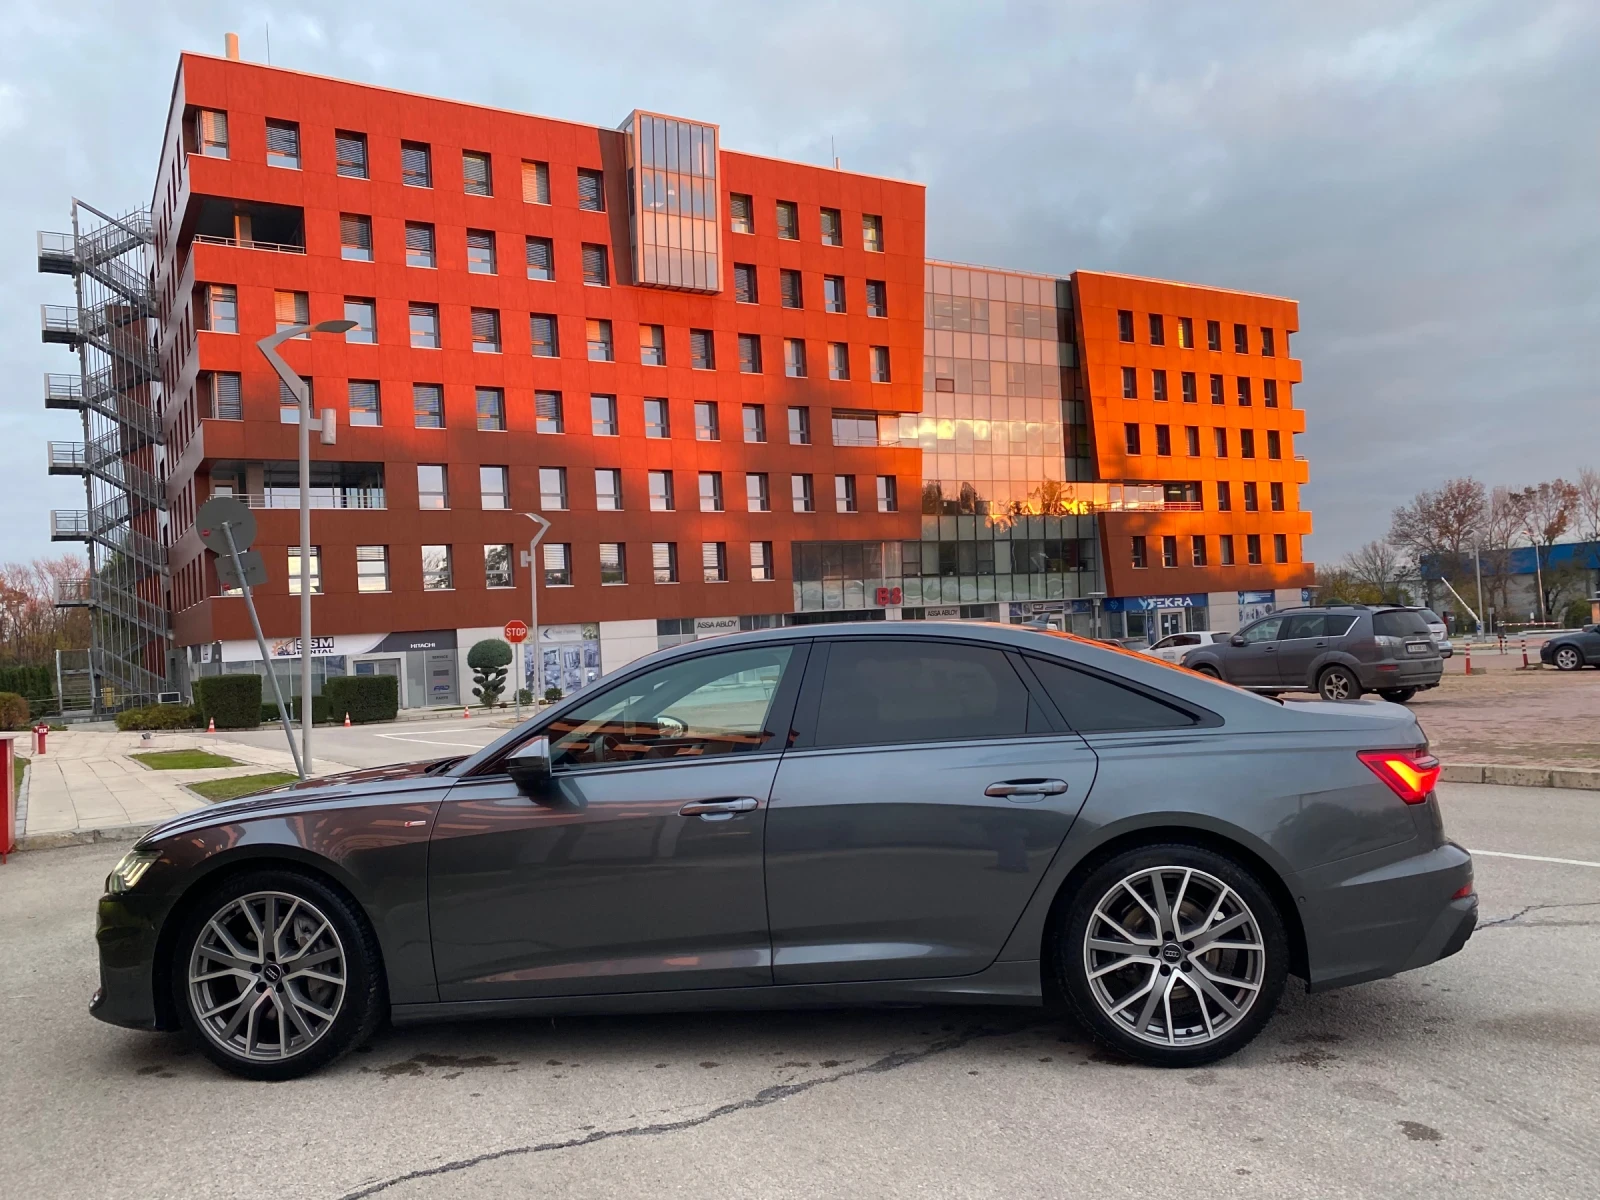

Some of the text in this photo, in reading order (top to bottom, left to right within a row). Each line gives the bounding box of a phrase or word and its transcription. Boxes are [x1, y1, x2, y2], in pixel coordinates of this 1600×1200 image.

[877, 587, 901, 605] B8
[716, 620, 737, 628] ABLOY
[506, 627, 526, 637] STOP
